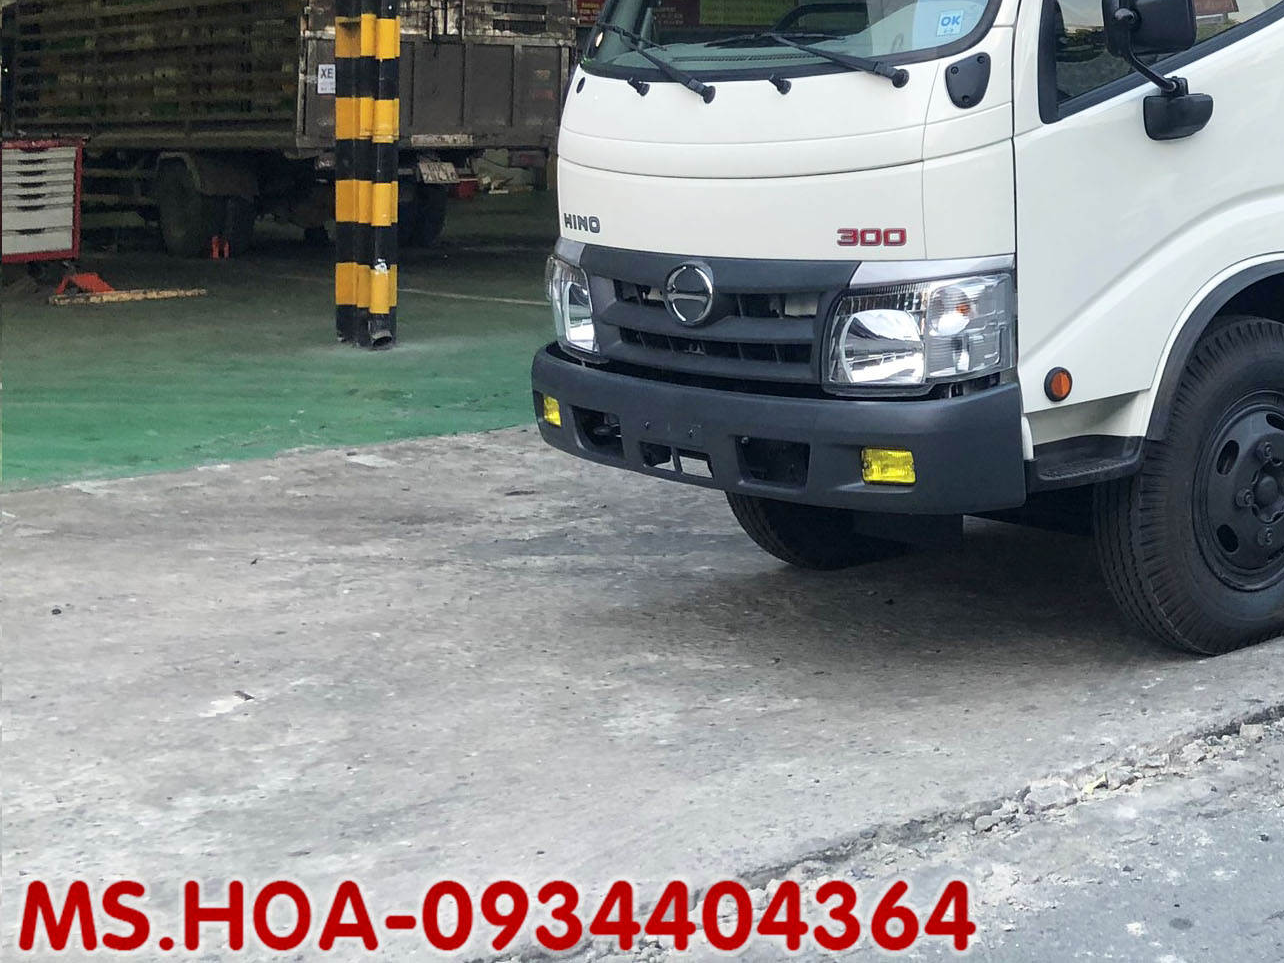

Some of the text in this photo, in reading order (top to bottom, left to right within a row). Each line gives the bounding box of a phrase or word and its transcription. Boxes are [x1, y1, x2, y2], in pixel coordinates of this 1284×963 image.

[941, 15, 961, 27] OK
[563, 212, 601, 234] HINO
[836, 227, 908, 247] 300
